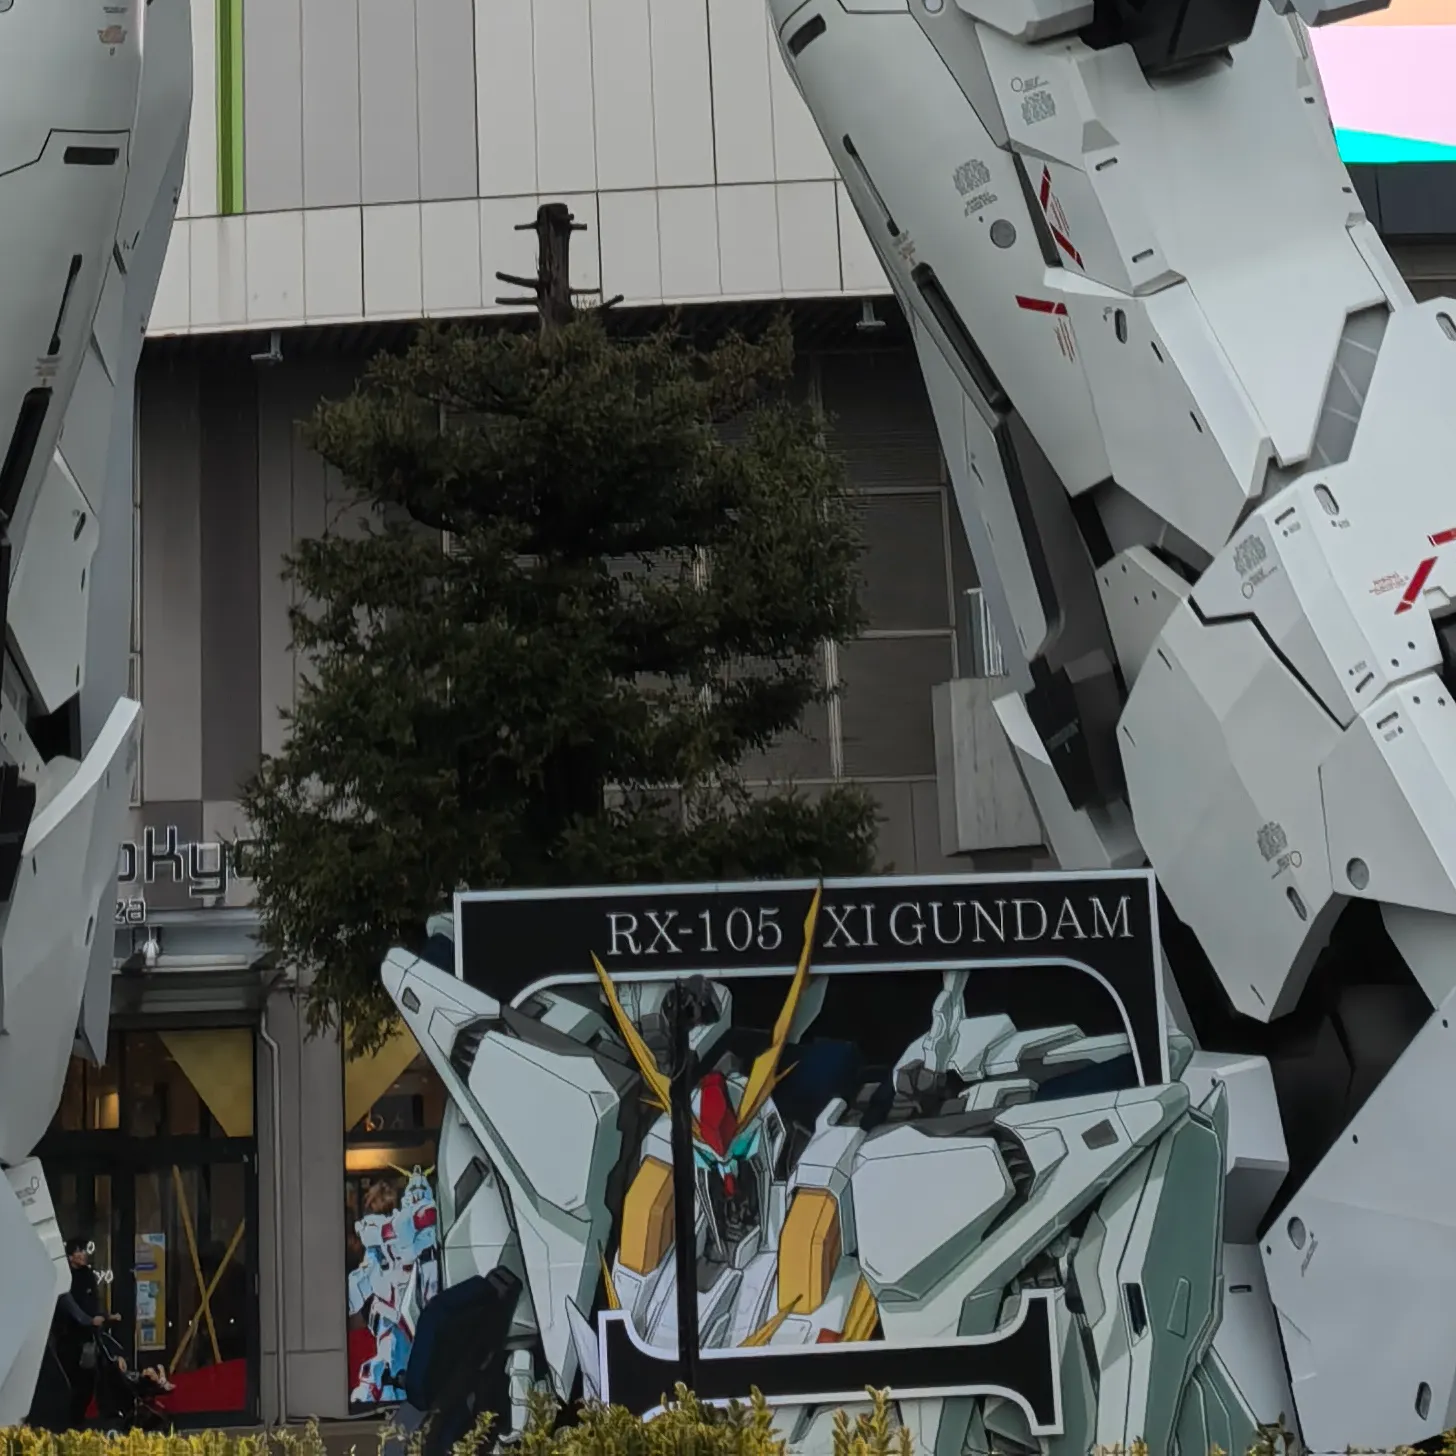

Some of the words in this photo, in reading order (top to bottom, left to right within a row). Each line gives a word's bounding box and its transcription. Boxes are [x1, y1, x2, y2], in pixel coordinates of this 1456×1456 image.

[606, 907, 784, 955] RX-105
[823, 903, 880, 949] XI
[889, 895, 1135, 946] GUNDAM
